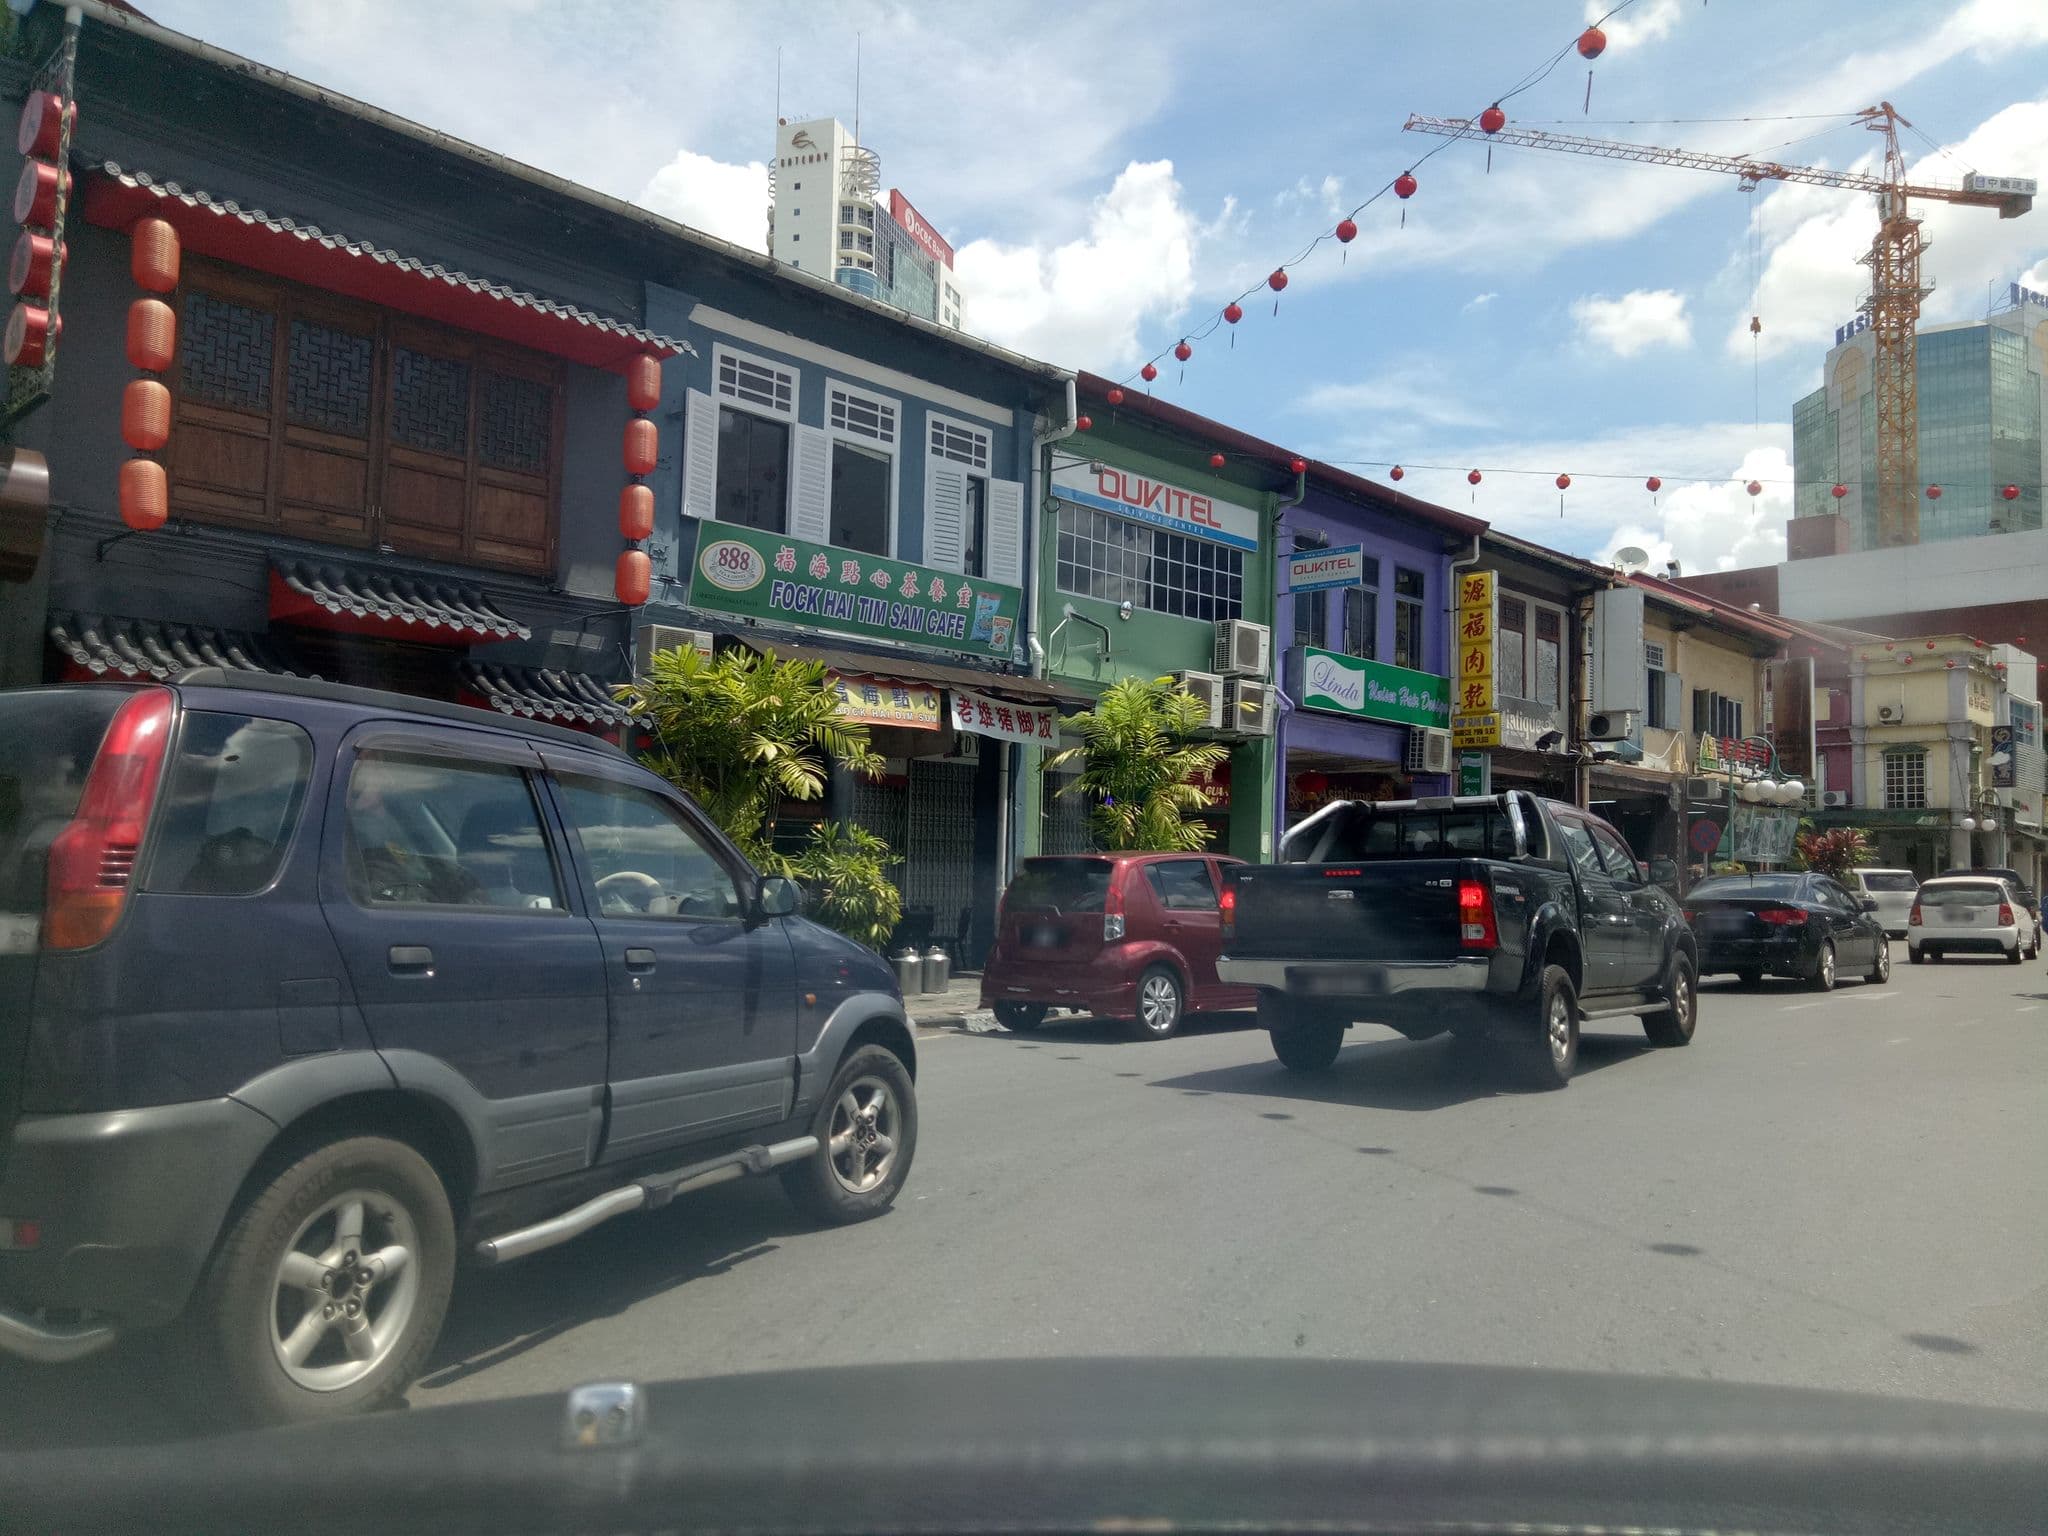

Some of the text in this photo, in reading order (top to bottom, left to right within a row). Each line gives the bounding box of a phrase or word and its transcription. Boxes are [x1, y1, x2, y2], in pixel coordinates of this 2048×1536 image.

[781, 152, 828, 168] GATEWAY
[914, 222, 946, 264] OCBC Bank
[1098, 468, 1222, 529] OUKITEL
[1118, 505, 1162, 523] SERVICE
[719, 547, 750, 570] 888
[1293, 557, 1356, 576] OUKITEL
[774, 544, 973, 609] 福海點心茶餐室
[769, 579, 823, 615] FOCK
[822, 589, 855, 621] HAI
[857, 595, 888, 627] TIM
[889, 601, 925, 632] SAM
[926, 608, 967, 640] CAFE
[1310, 661, 1360, 702] Linda
[872, 710, 890, 718] HAI
[895, 711, 913, 720] DIM
